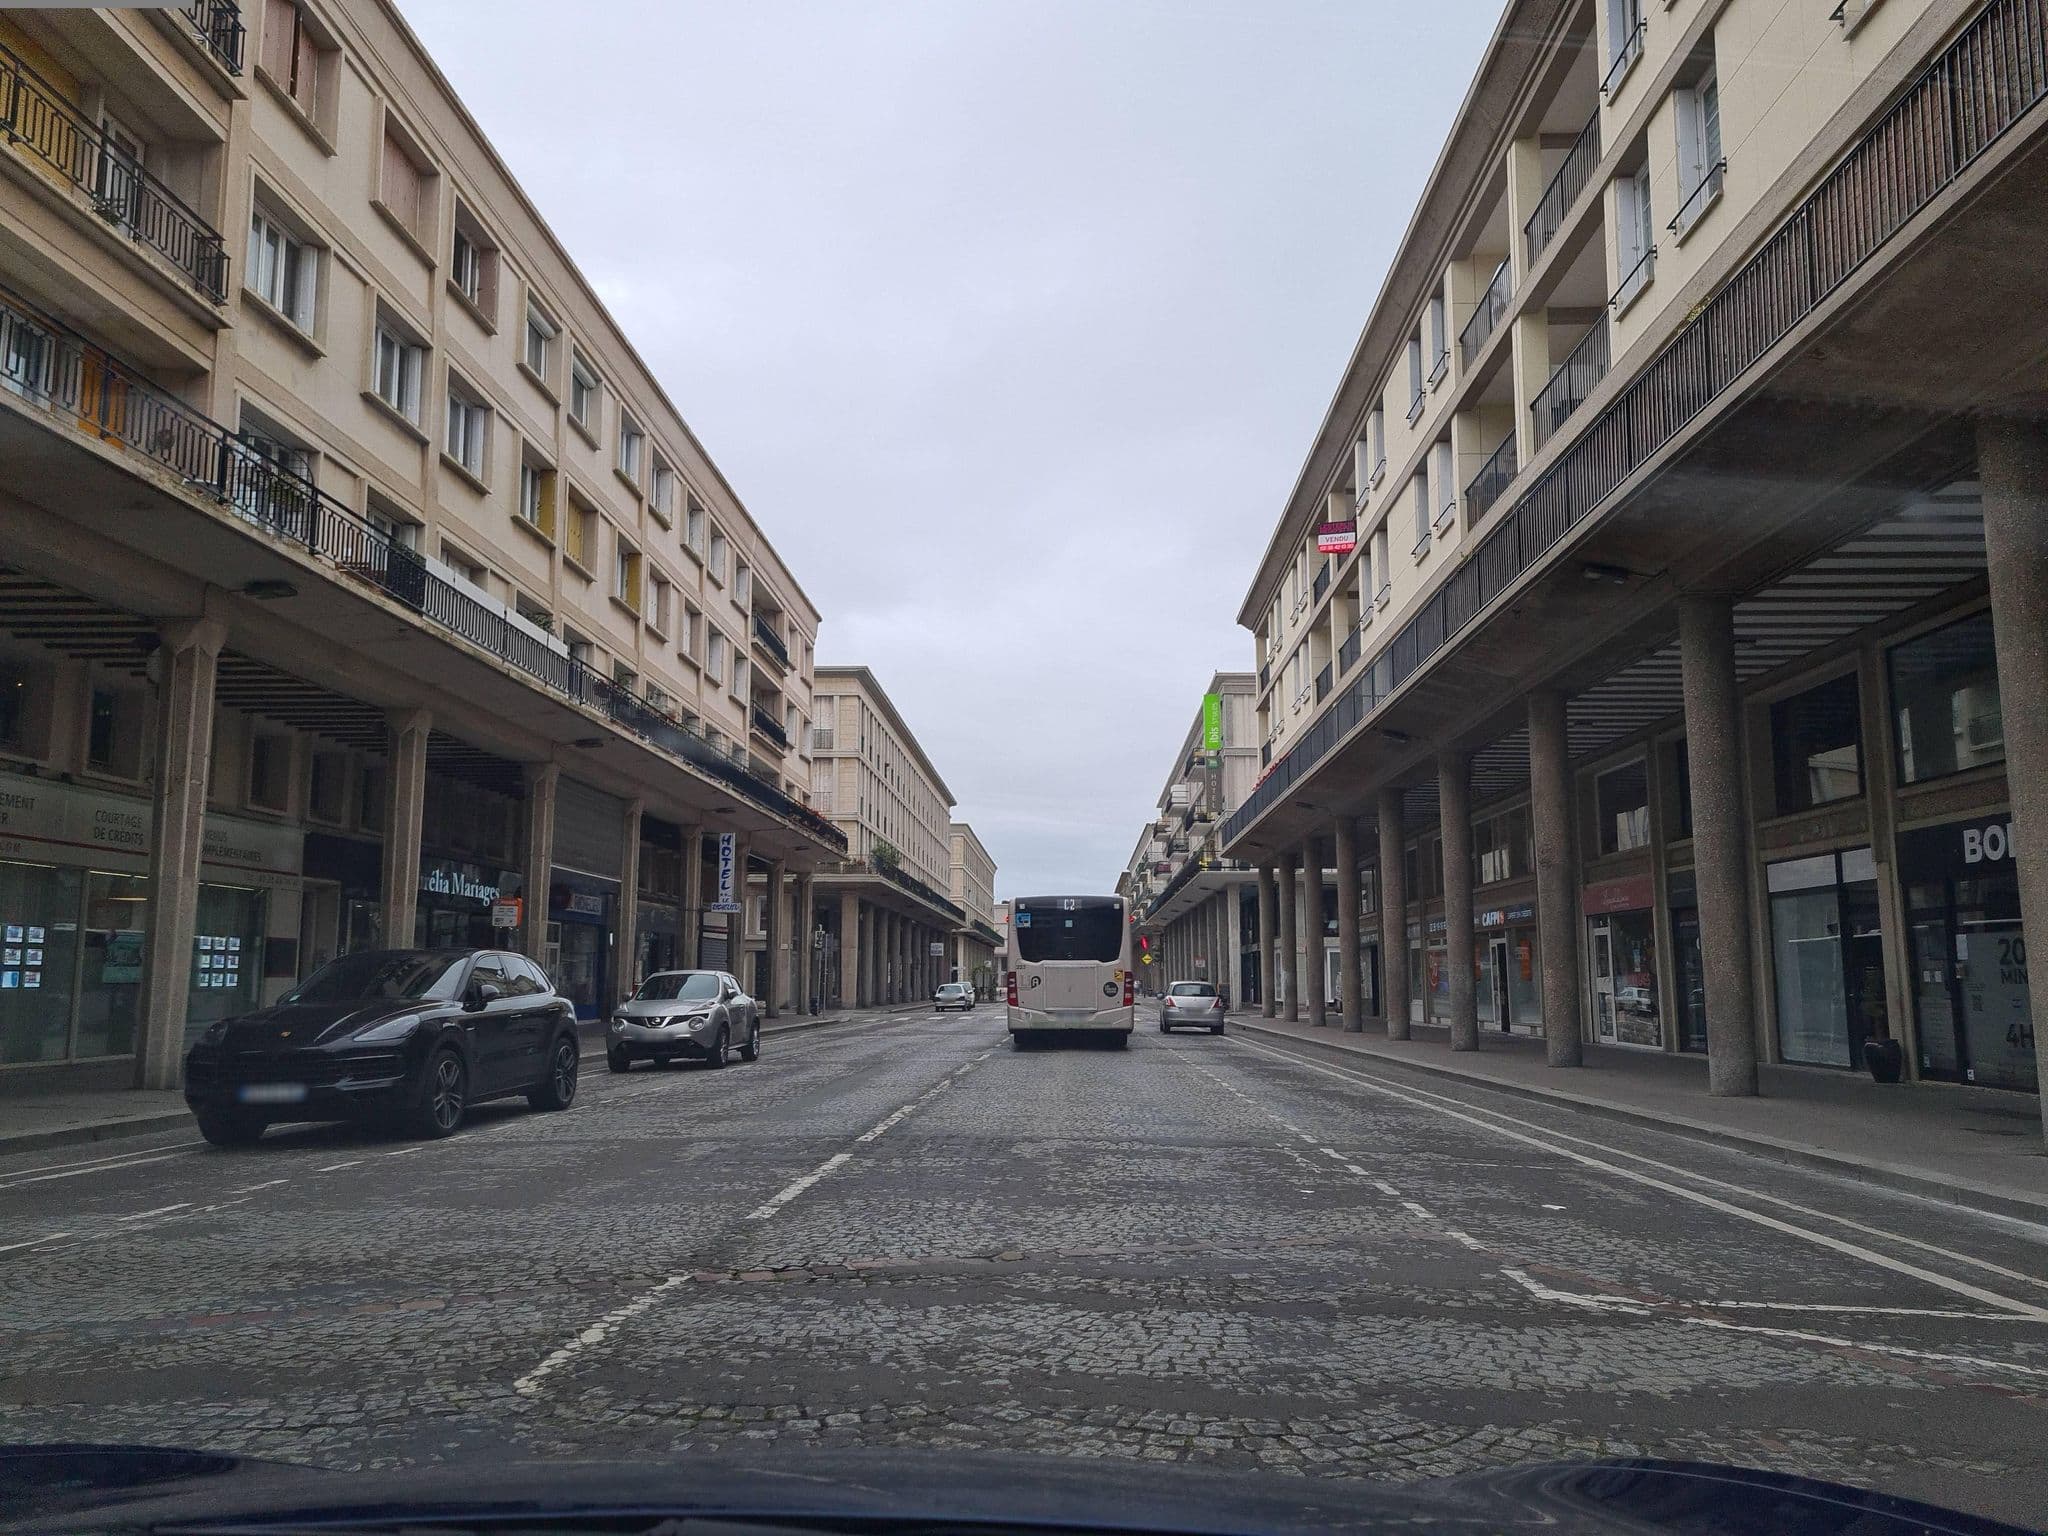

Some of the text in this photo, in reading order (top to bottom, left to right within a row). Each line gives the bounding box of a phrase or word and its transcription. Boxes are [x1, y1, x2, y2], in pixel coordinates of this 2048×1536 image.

[1325, 535, 1349, 543] VENDU
[1208, 727, 1219, 744] ibis
[95, 809, 144, 829] COURTAGE
[94, 826, 107, 840] DE
[721, 834, 732, 890] HOTEL
[451, 872, 501, 907] Mariages
[1064, 898, 1075, 911] C2
